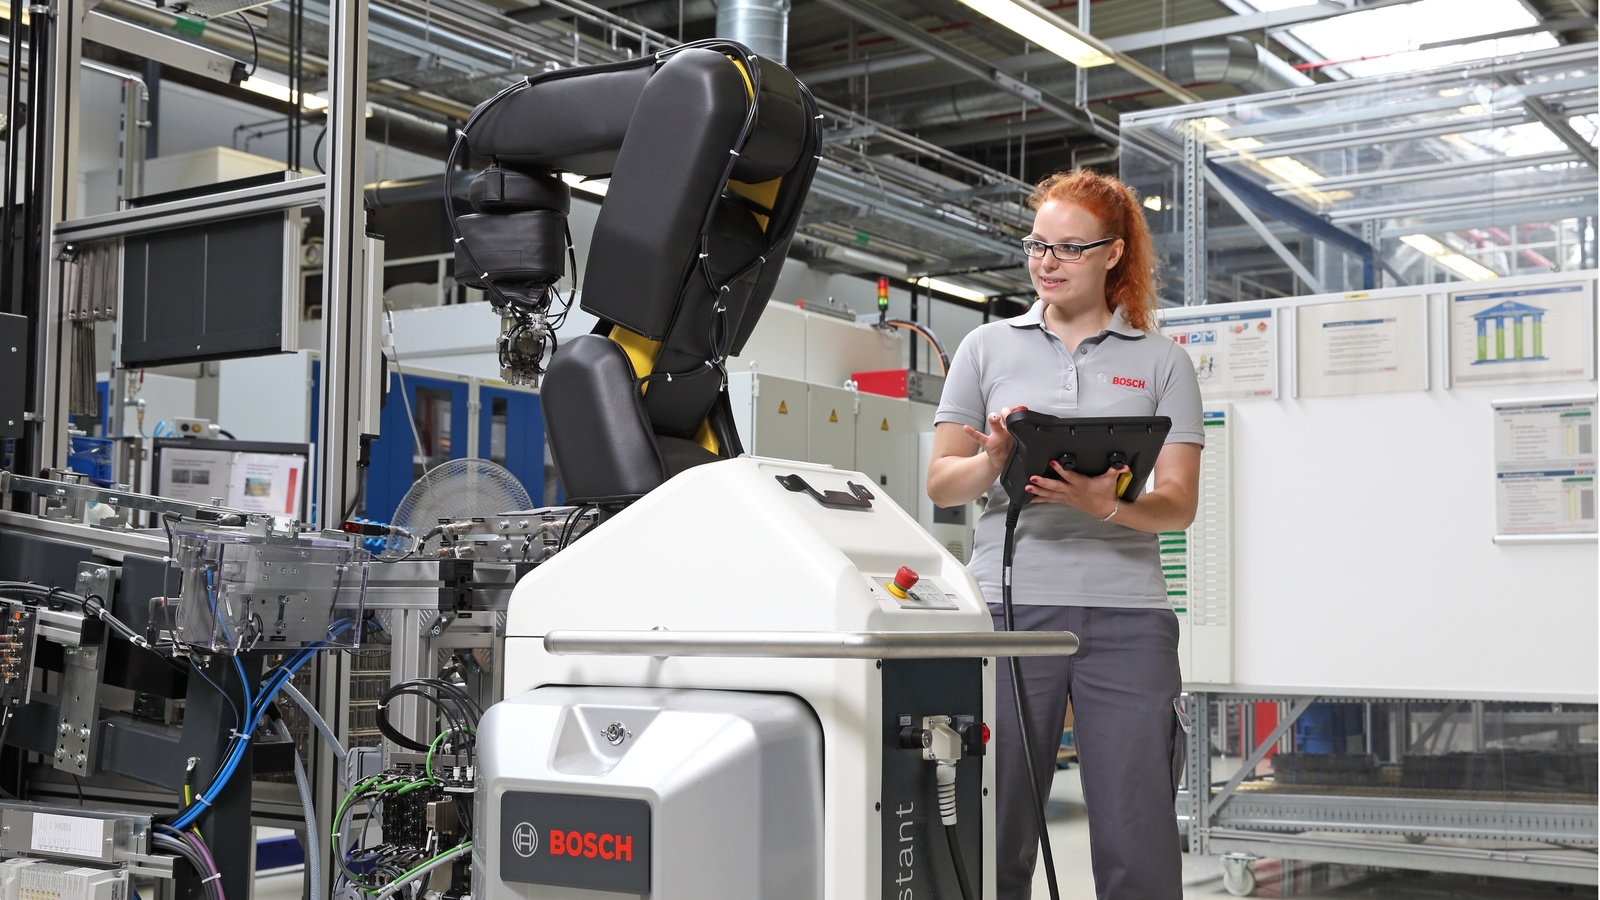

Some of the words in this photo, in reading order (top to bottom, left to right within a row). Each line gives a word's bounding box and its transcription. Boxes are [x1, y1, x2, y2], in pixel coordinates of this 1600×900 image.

[1169, 331, 1216, 346] TPM
[1112, 376, 1146, 389] BOSCH
[550, 829, 632, 862] BOSCH
